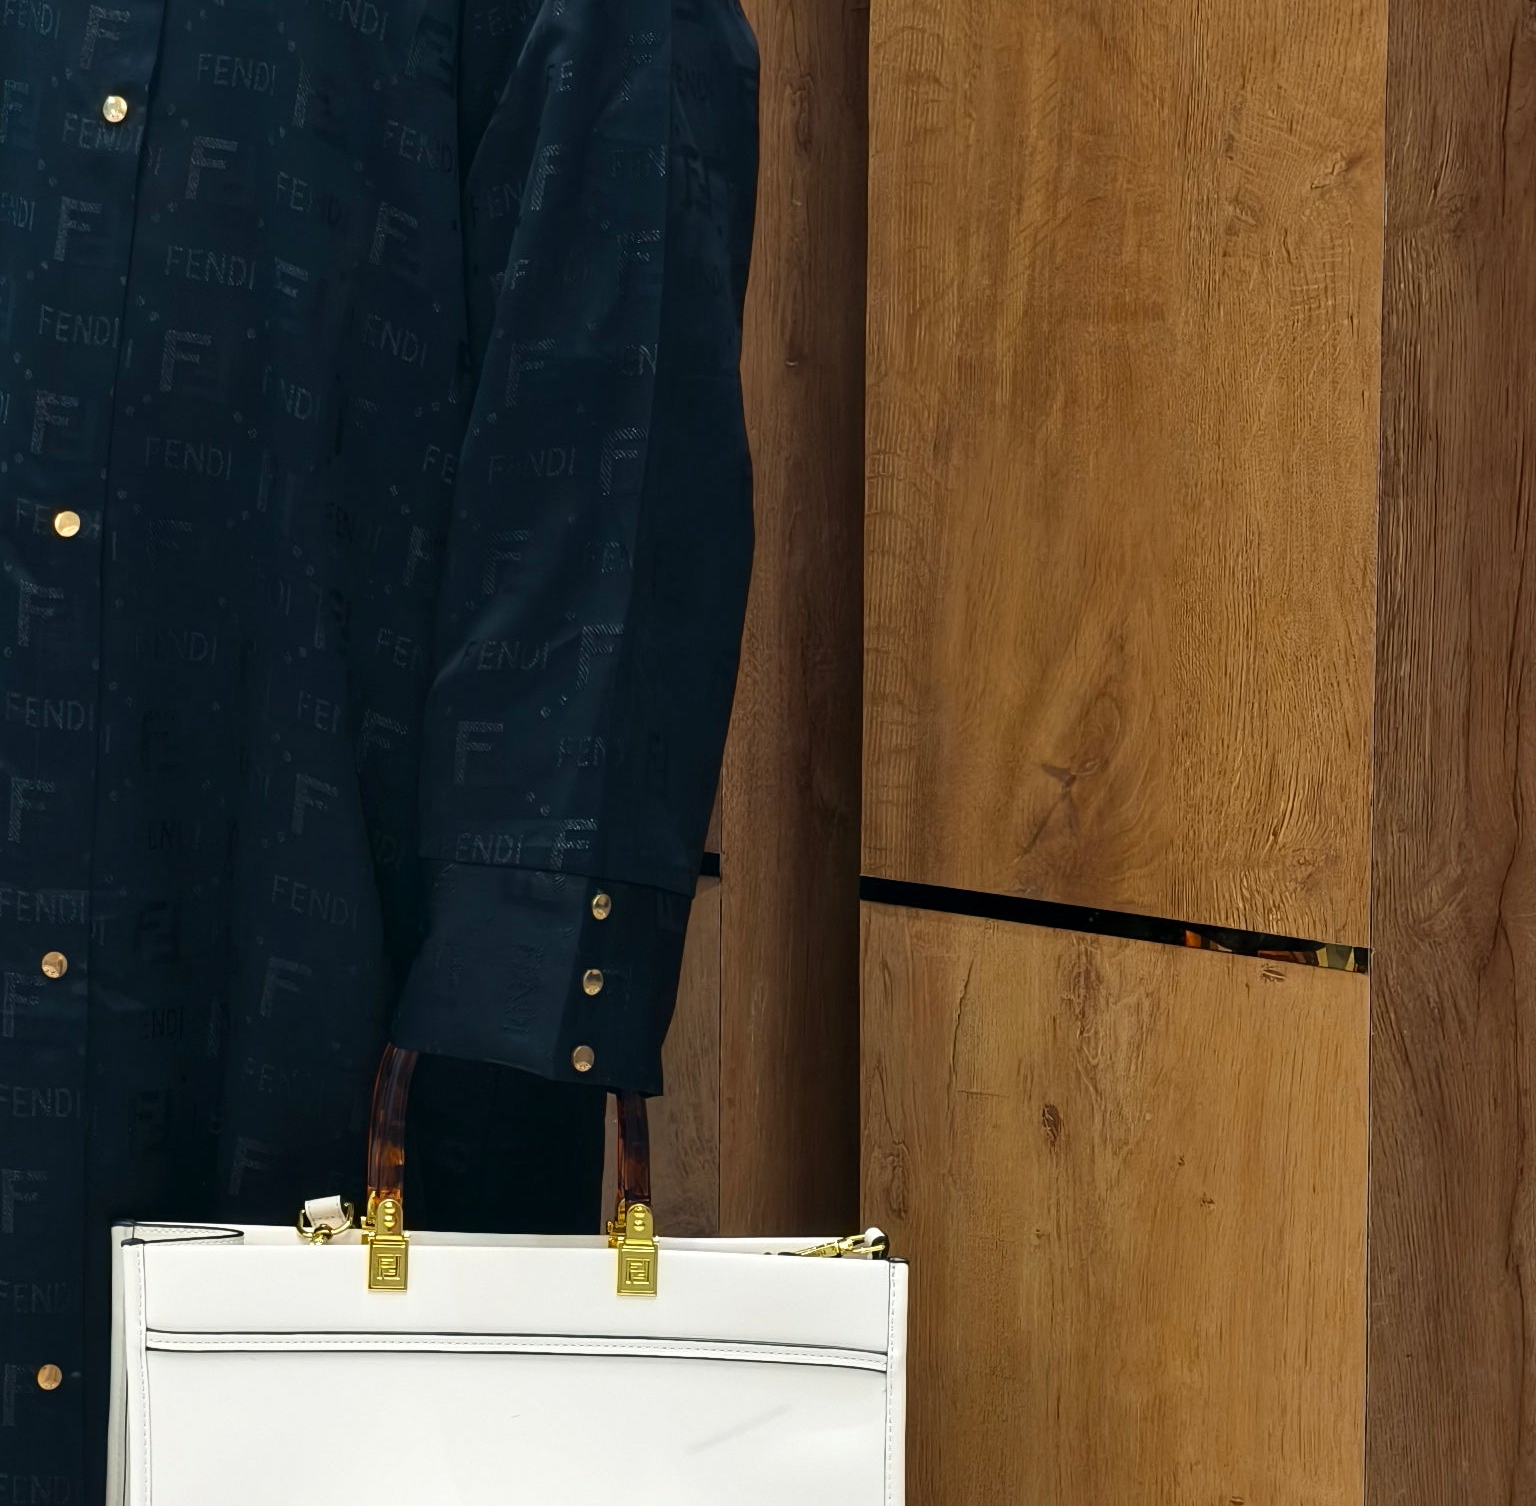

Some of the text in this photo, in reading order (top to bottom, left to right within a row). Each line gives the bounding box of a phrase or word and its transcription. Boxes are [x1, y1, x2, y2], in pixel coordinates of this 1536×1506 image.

[79, 5, 131, 70] F
[198, 53, 278, 96] FENDI
[63, 112, 143, 155] FENDI
[185, 135, 238, 199] F
[54, 196, 103, 262] F
[369, 201, 418, 265] F
[616, 229, 664, 293] F
[166, 245, 256, 291] FENDI
[39, 304, 120, 348] FENDI
[160, 329, 212, 393] F
[505, 338, 559, 407] F
[31, 390, 80, 454] F
[145, 437, 232, 481] FENDI
[599, 428, 647, 498] F
[481, 528, 529, 596] F
[17, 579, 64, 647] F
[576, 622, 625, 692] F
[5, 692, 96, 731] FENDI
[453, 721, 504, 784] F
[8, 774, 57, 844] F
[290, 773, 339, 836] F
[550, 816, 598, 890] F
[271, 874, 358, 927] FENDI
[2, 971, 48, 1038] F
[260, 954, 312, 1018] F
[1, 1167, 48, 1234] F
